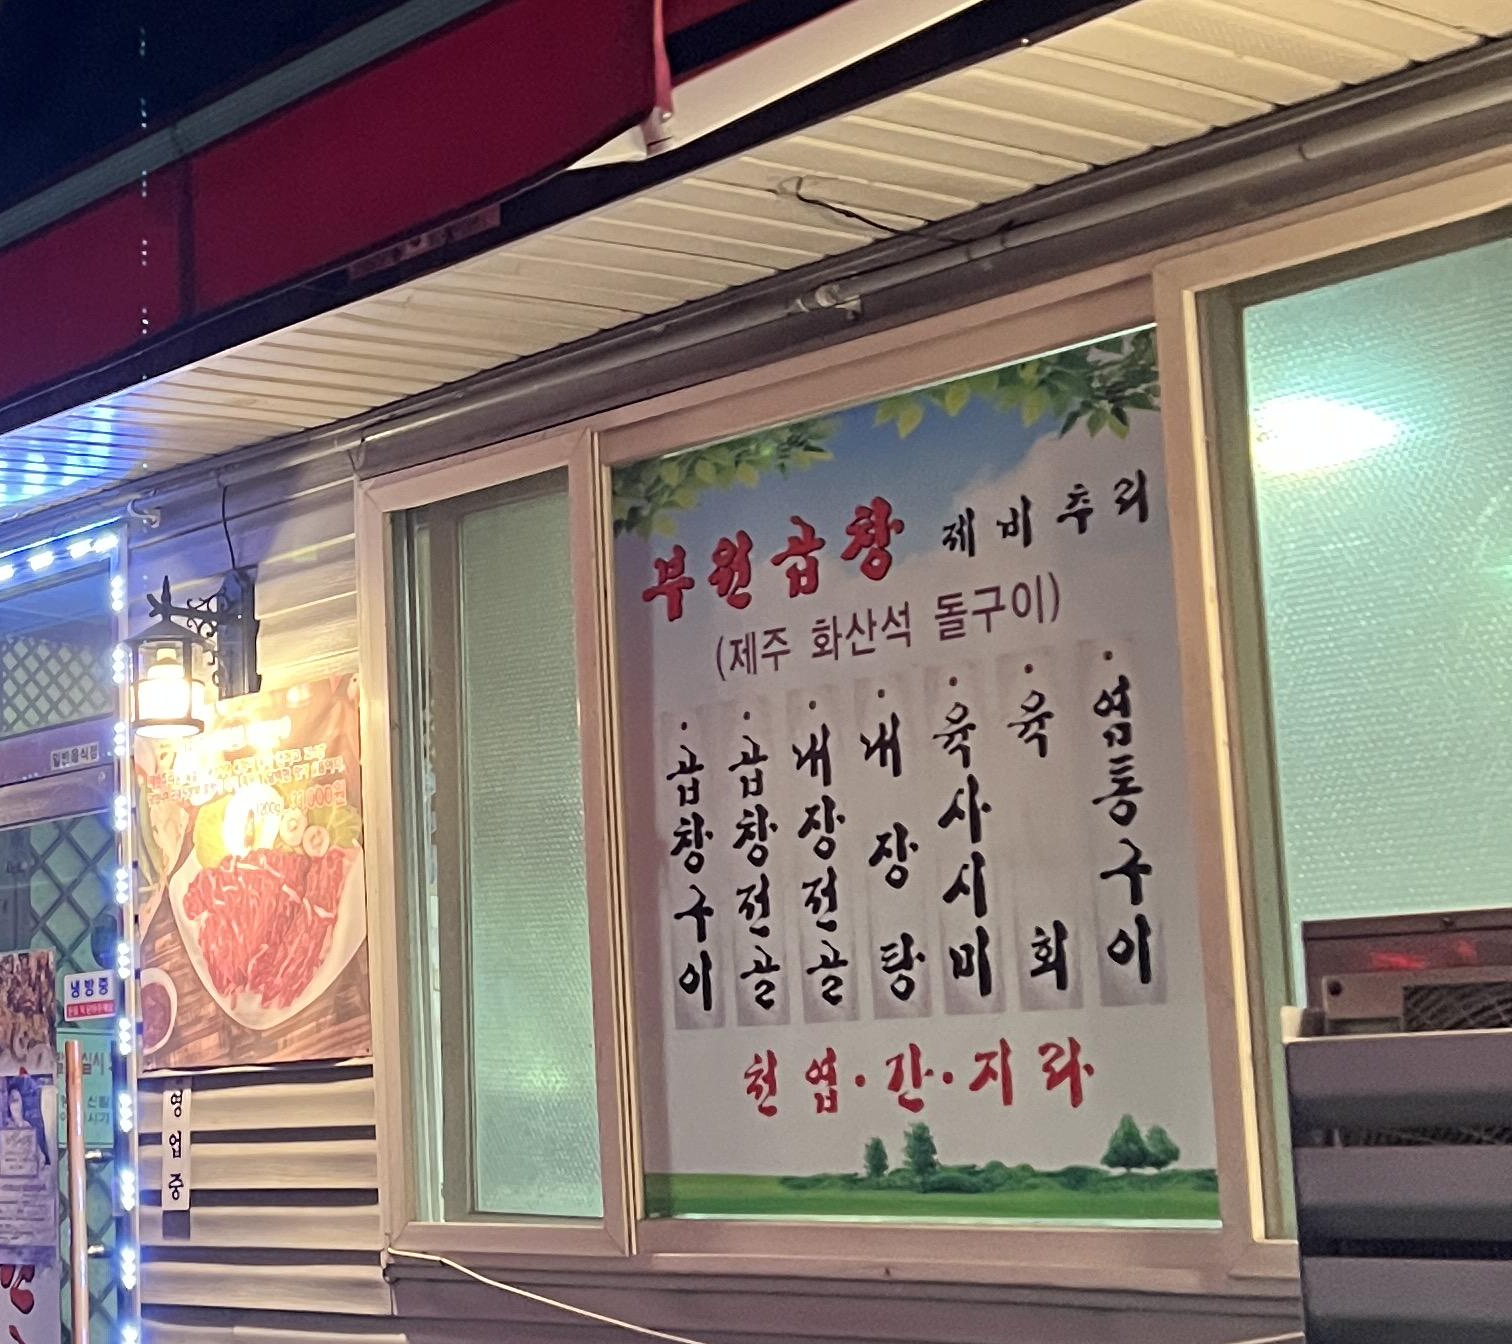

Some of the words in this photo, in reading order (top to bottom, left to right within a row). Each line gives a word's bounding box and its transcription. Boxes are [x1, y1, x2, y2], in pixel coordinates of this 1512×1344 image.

[641, 496, 905, 623] 부원곱창
[941, 467, 1152, 559] 제비추리
[715, 625, 792, 682] (제주
[810, 600, 913, 662] 화산석
[933, 571, 1061, 643] 돌구이)
[666, 744, 714, 1012] 곱창구이
[728, 735, 782, 1011] 곱창전골
[792, 722, 849, 1006] 내장전골
[859, 712, 926, 1002] 내장탕
[1091, 674, 1154, 985] 염통구이
[70, 977, 109, 999] 냉방중
